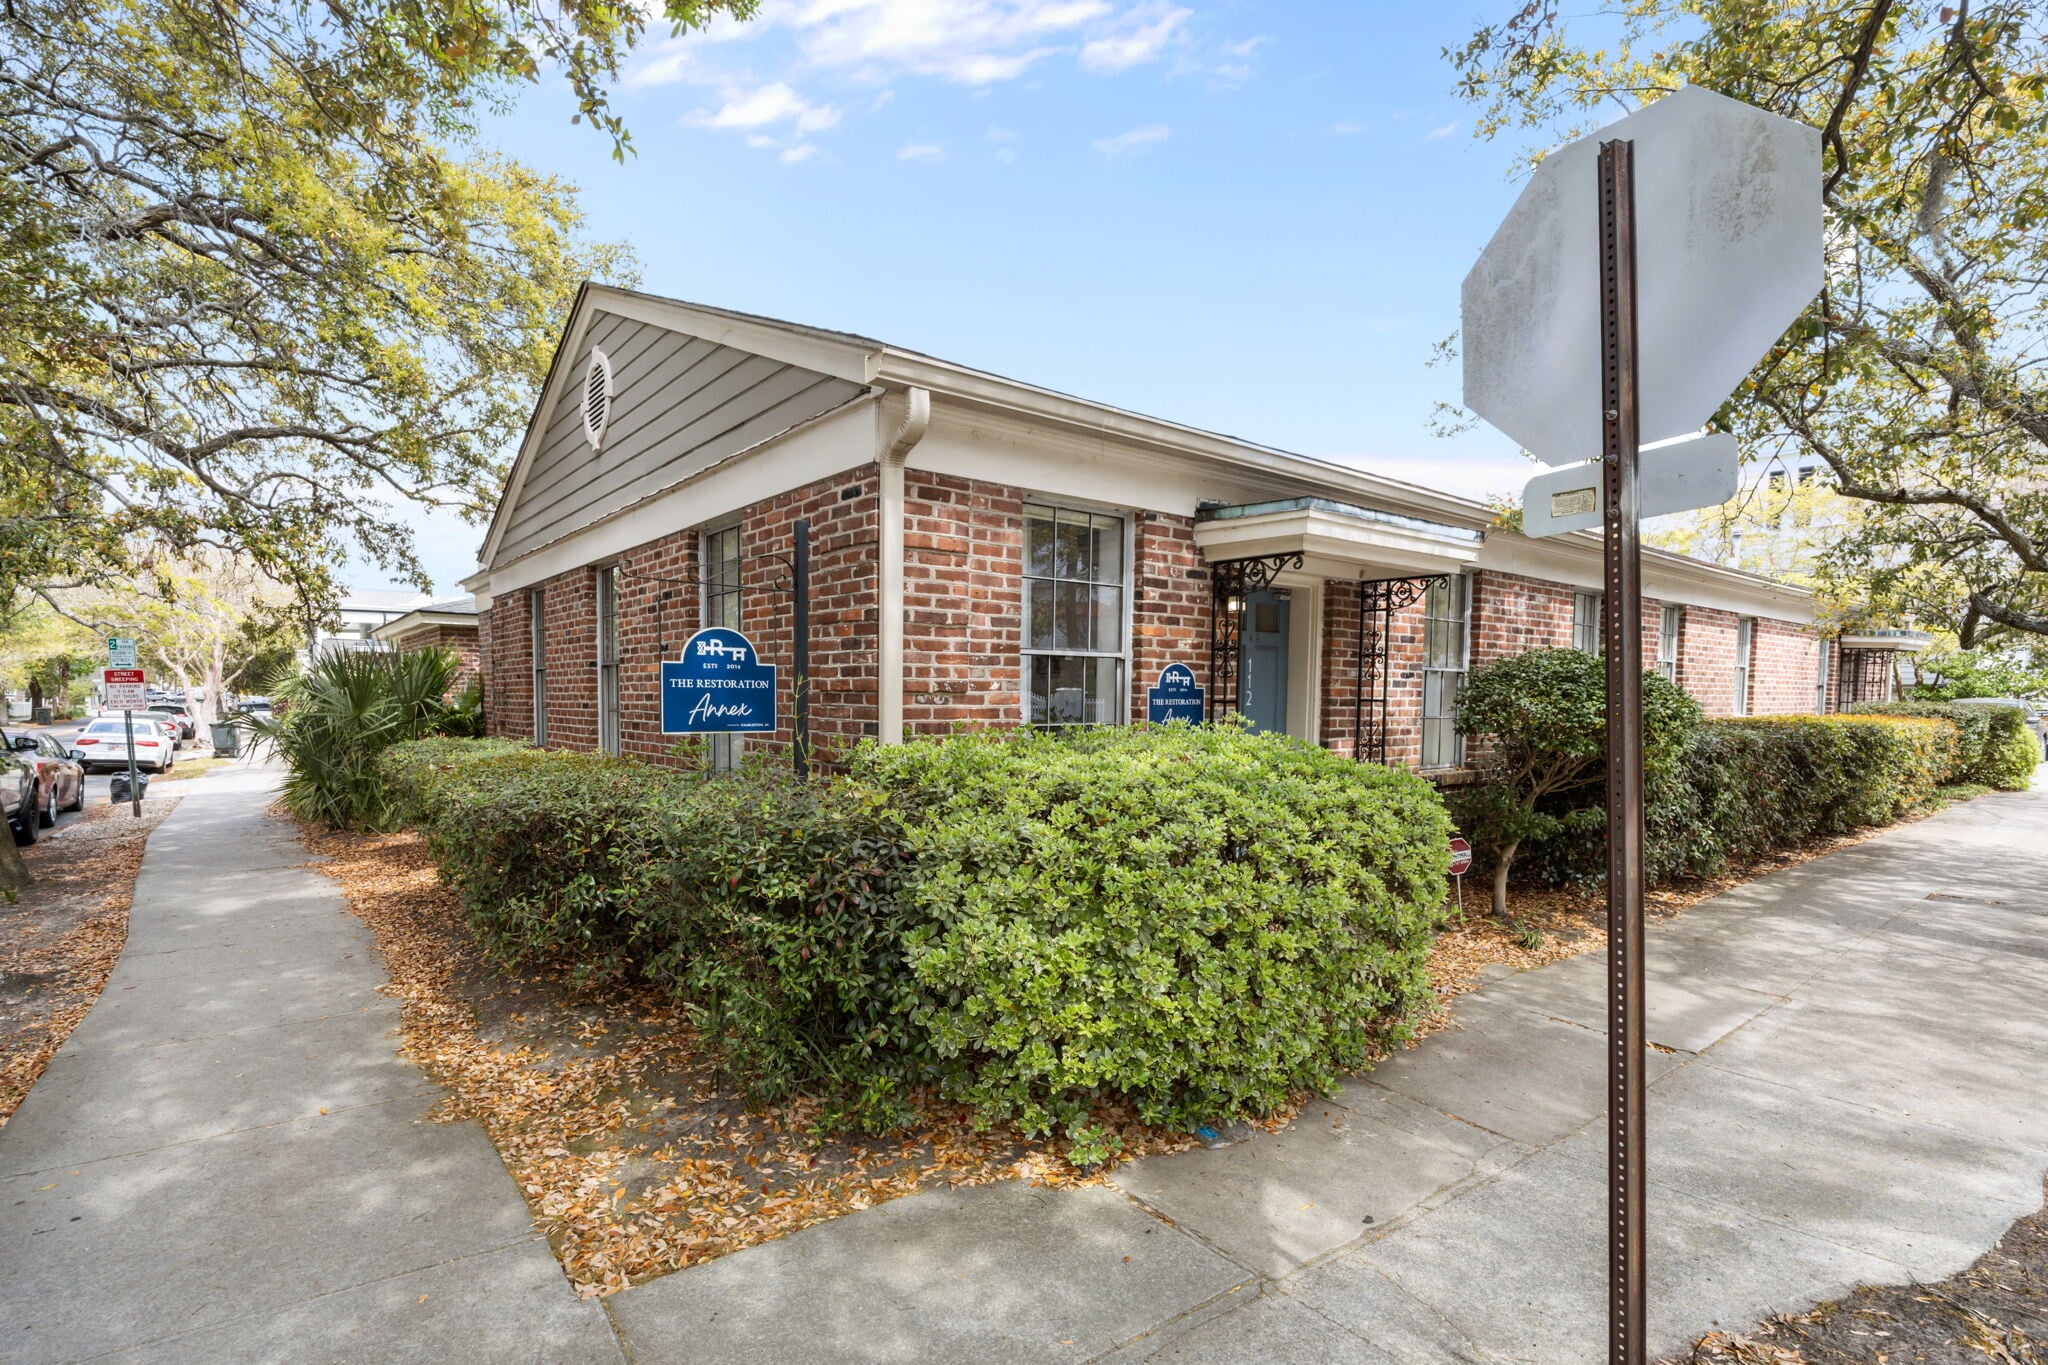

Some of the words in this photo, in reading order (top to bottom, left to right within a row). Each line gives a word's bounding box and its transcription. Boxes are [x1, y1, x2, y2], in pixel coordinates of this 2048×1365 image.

[109, 640, 116, 649] 2
[670, 679, 694, 688] THE
[696, 679, 769, 689] RESTORATION
[1152, 698, 1164, 706] THE
[1165, 698, 1202, 706] RESTORATION
[688, 692, 753, 725] Annex
